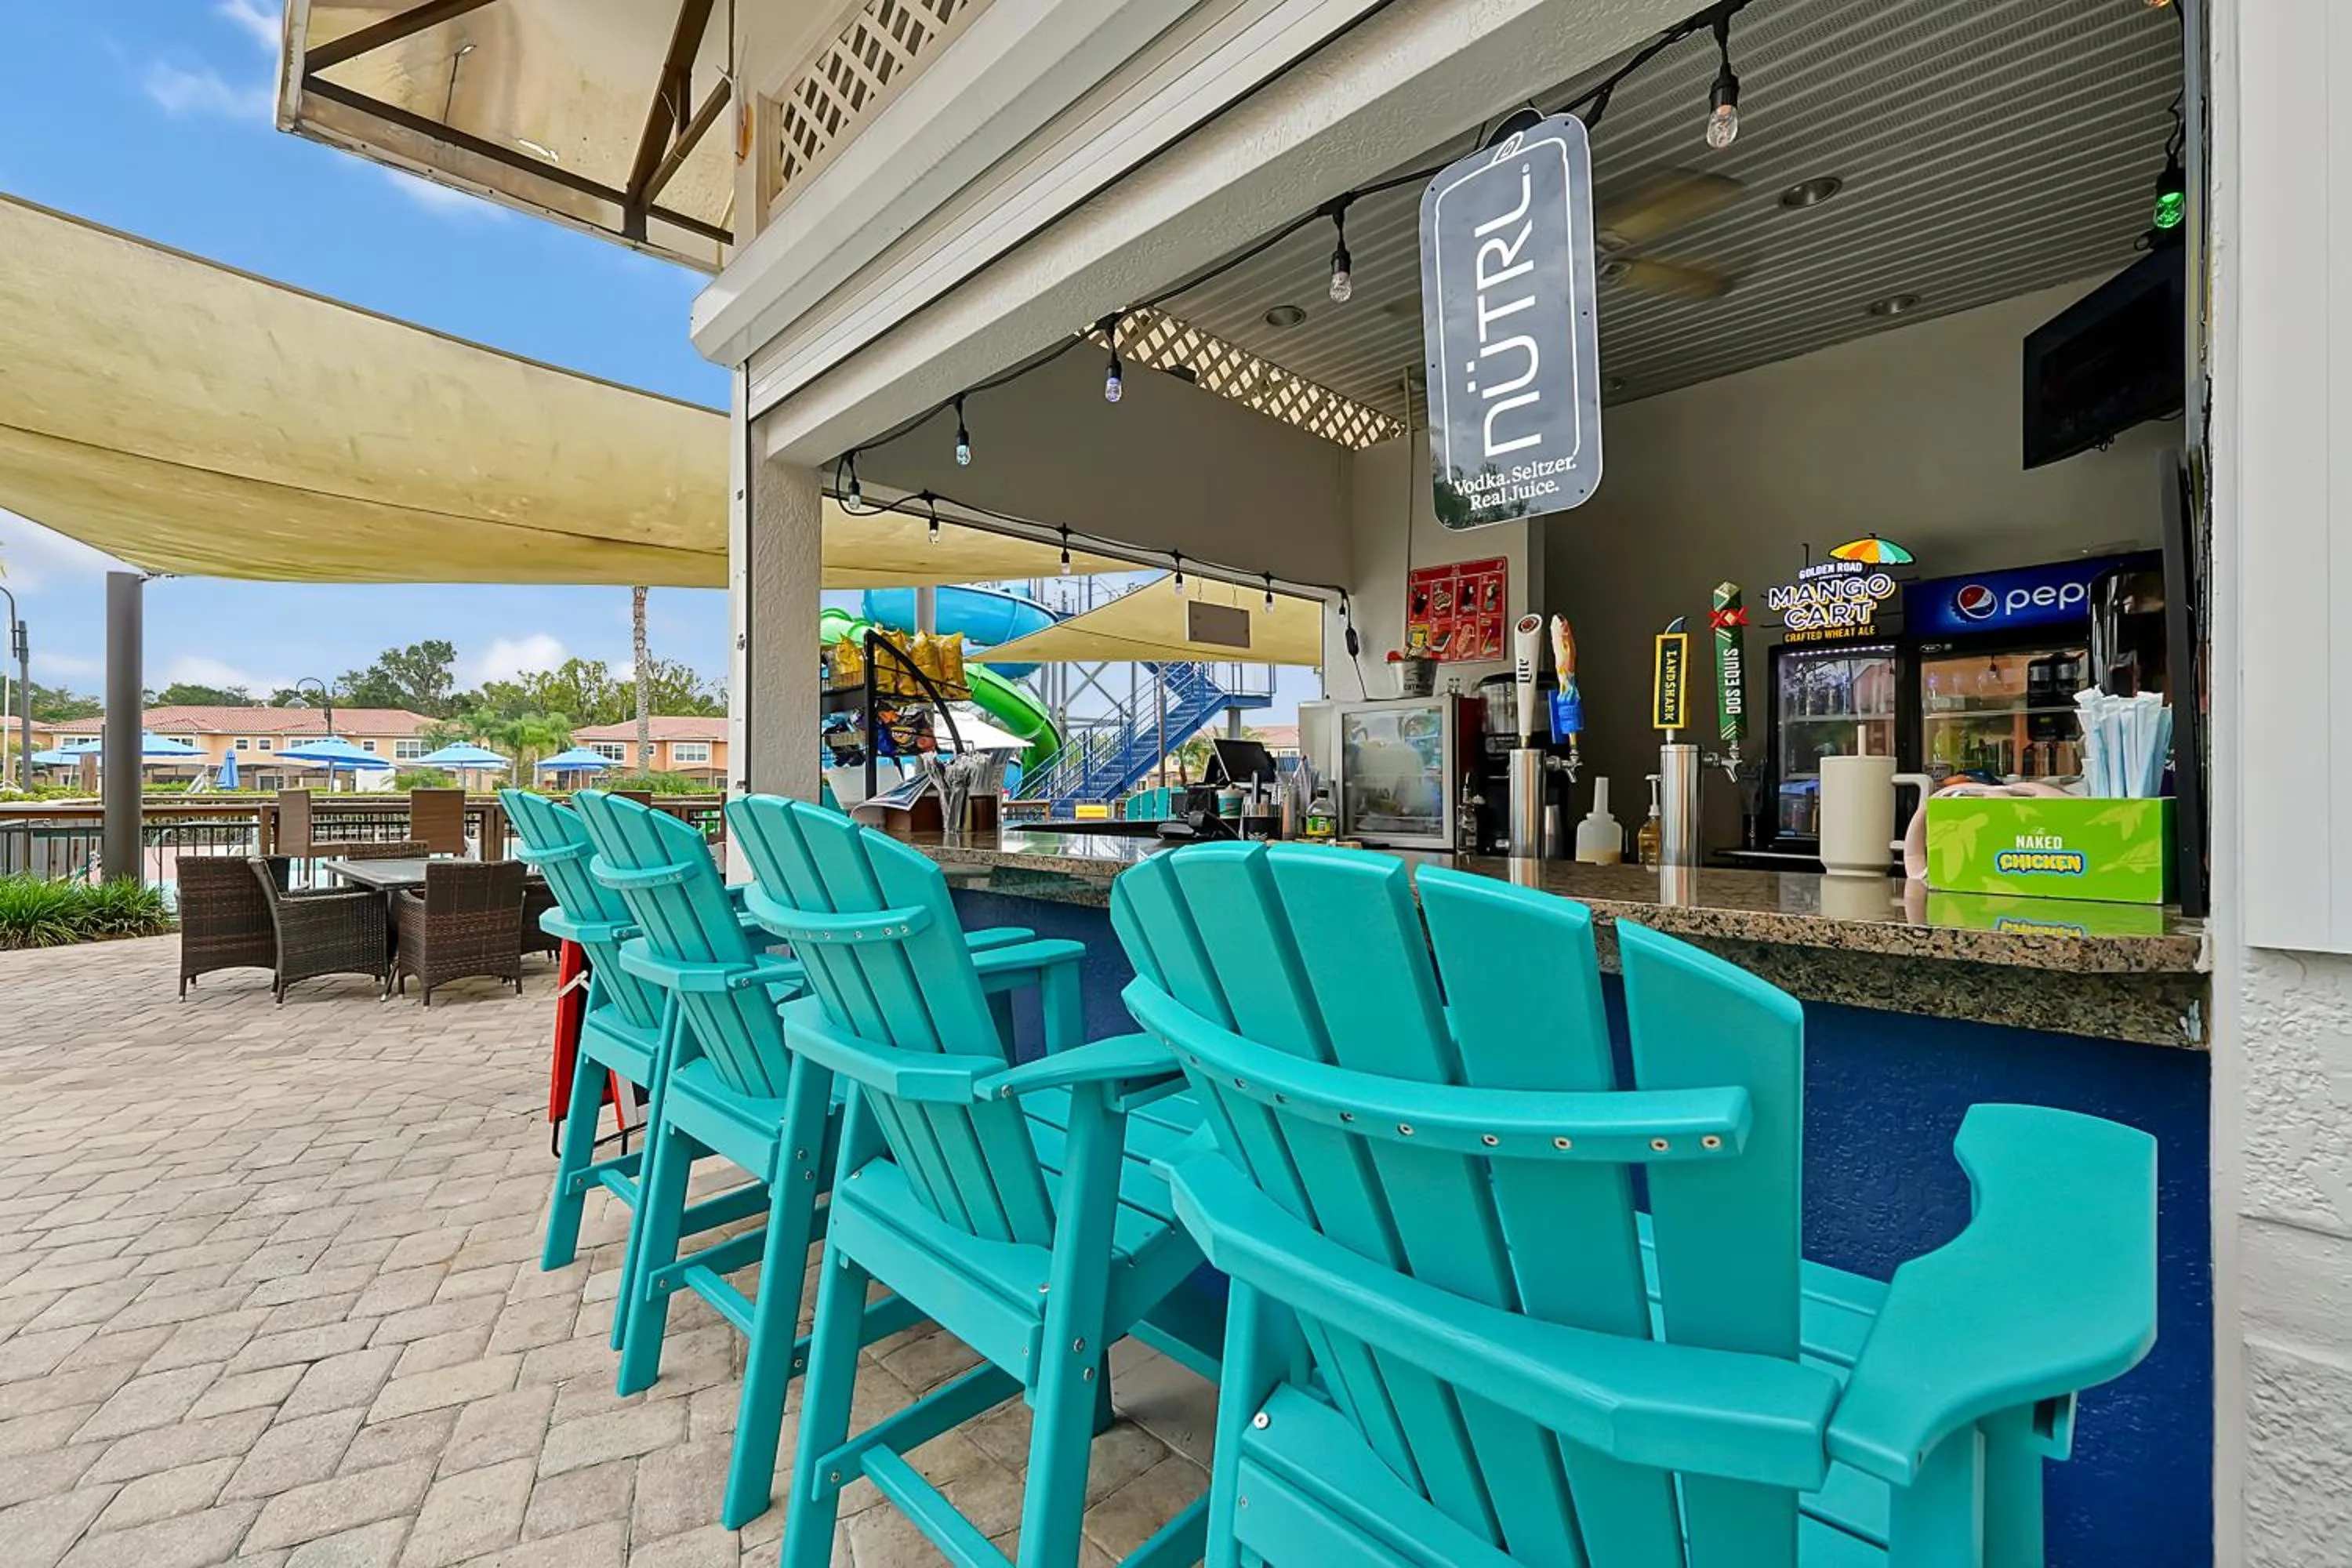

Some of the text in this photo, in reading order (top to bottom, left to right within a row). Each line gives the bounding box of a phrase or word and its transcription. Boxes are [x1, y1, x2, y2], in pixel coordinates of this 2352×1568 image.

[1454, 456, 1577, 495] Vodka. Seltzer.
[1471, 480, 1559, 511] Real Juice.
[1799, 564, 1835, 579] GOLDEN
[1837, 562, 1862, 572] ROAD
[1769, 574, 1894, 610] MANGO
[2005, 583, 2086, 615] pep
[1784, 599, 1877, 630] CART
[1785, 625, 1875, 642] CRAFTED WHEAT ALE
[1518, 659, 1532, 684] Lite
[1664, 650, 1678, 720] LANDSHARK
[1723, 648, 1741, 714] DOS EQUIS
[2016, 835, 2063, 849] NAKED
[1998, 853, 2082, 873] CHICKEN
